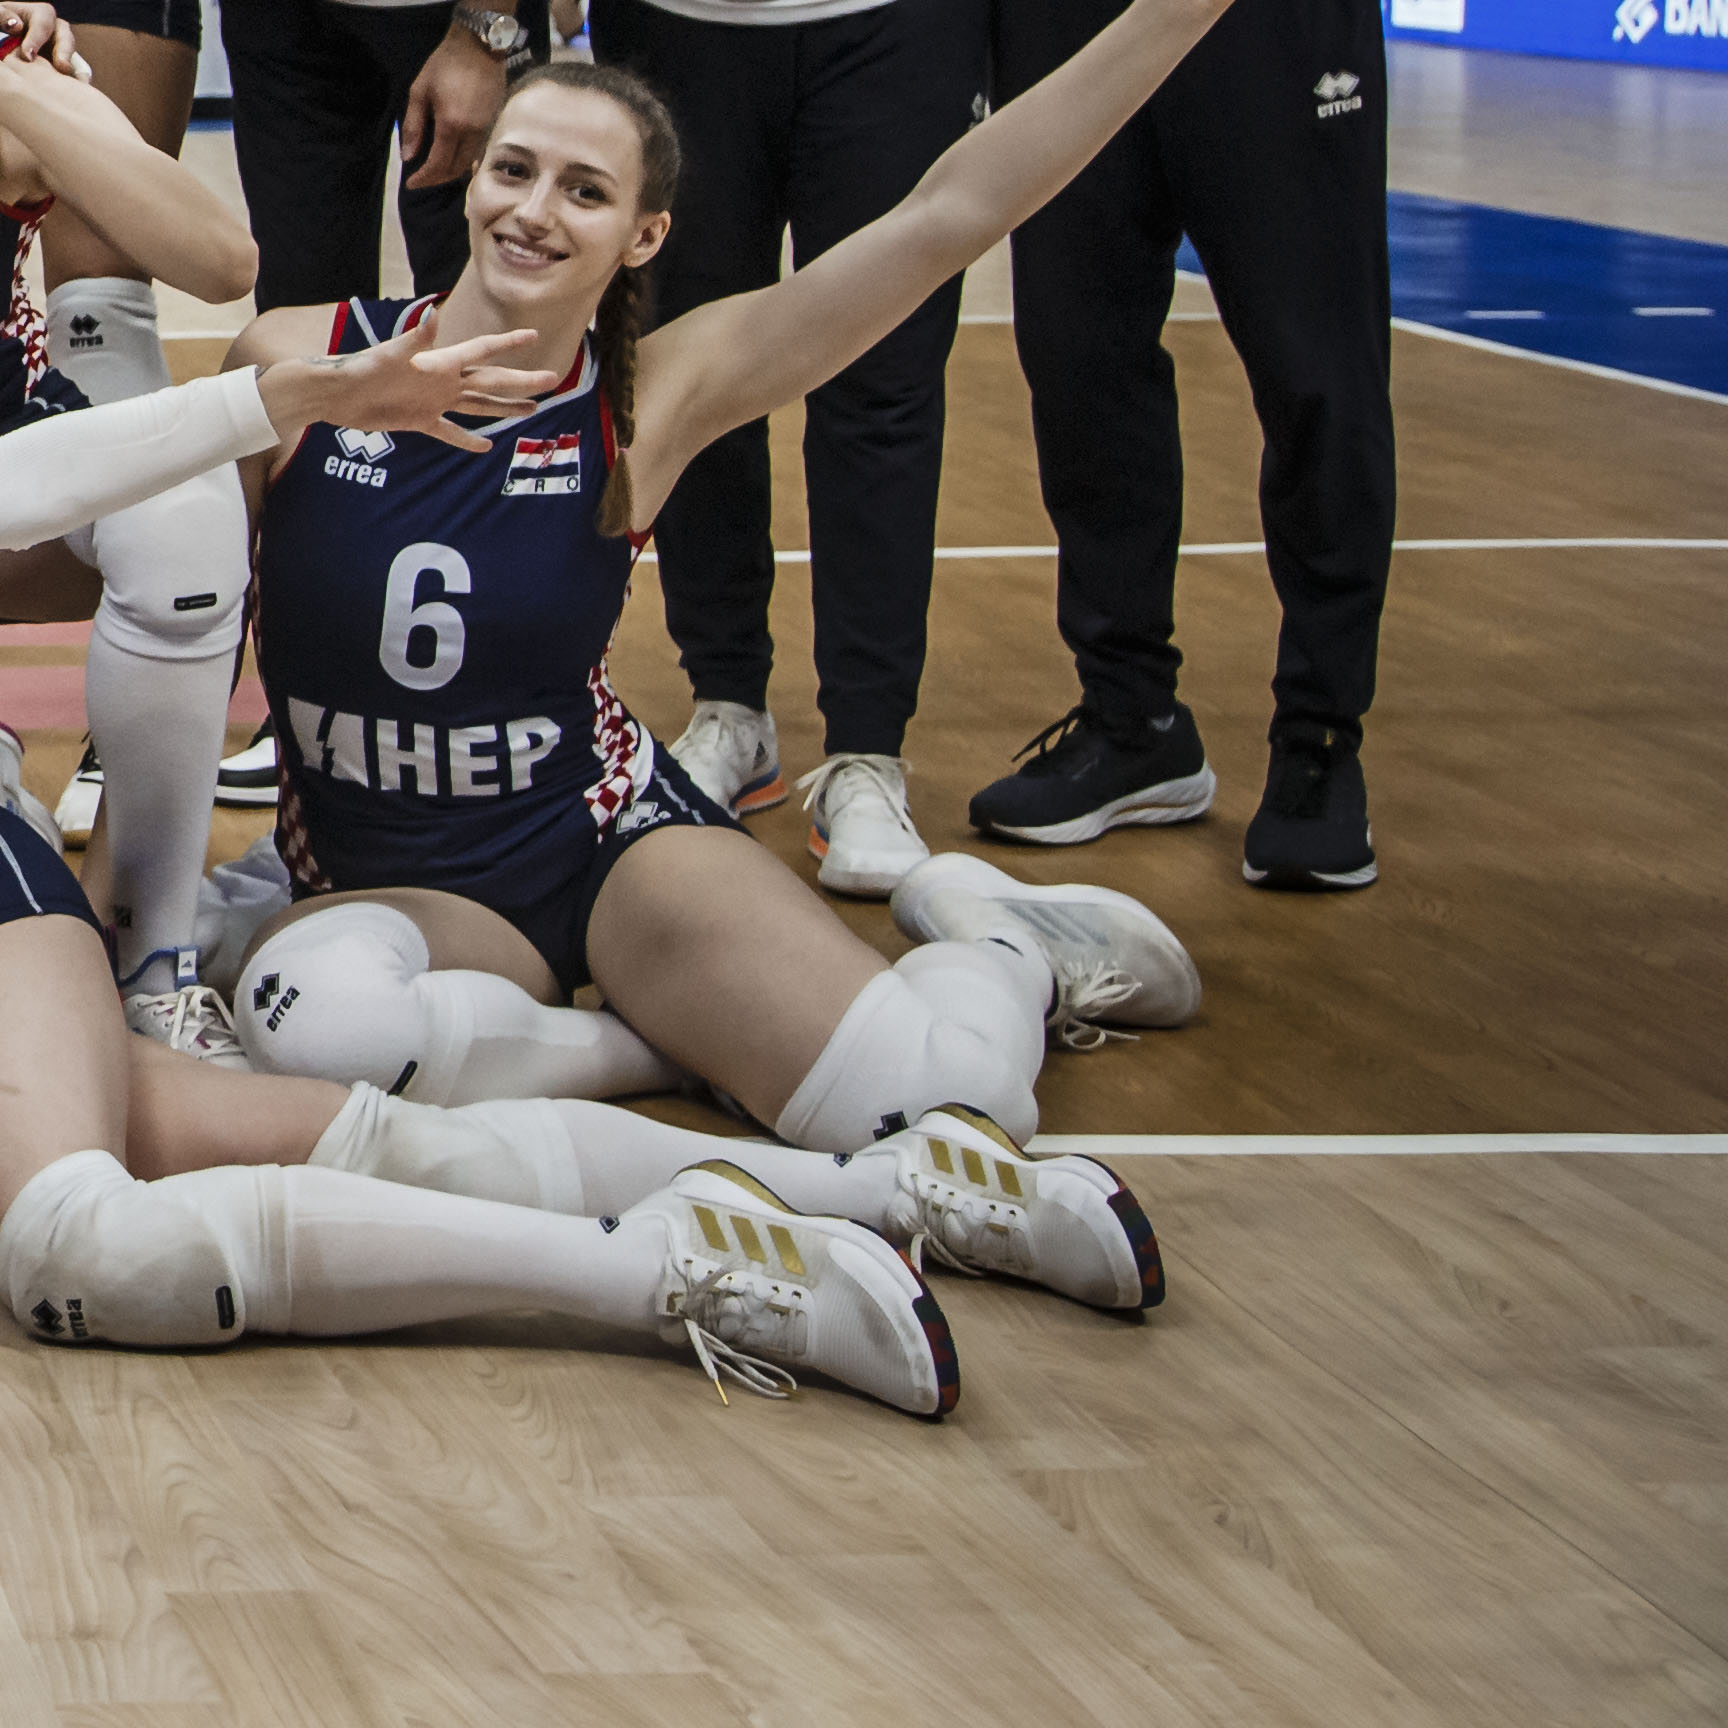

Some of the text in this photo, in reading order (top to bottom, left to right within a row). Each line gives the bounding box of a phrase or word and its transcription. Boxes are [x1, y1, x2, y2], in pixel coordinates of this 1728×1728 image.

[323, 455, 388, 488] errea
[379, 541, 472, 691] 6
[265, 985, 300, 1033] errea
